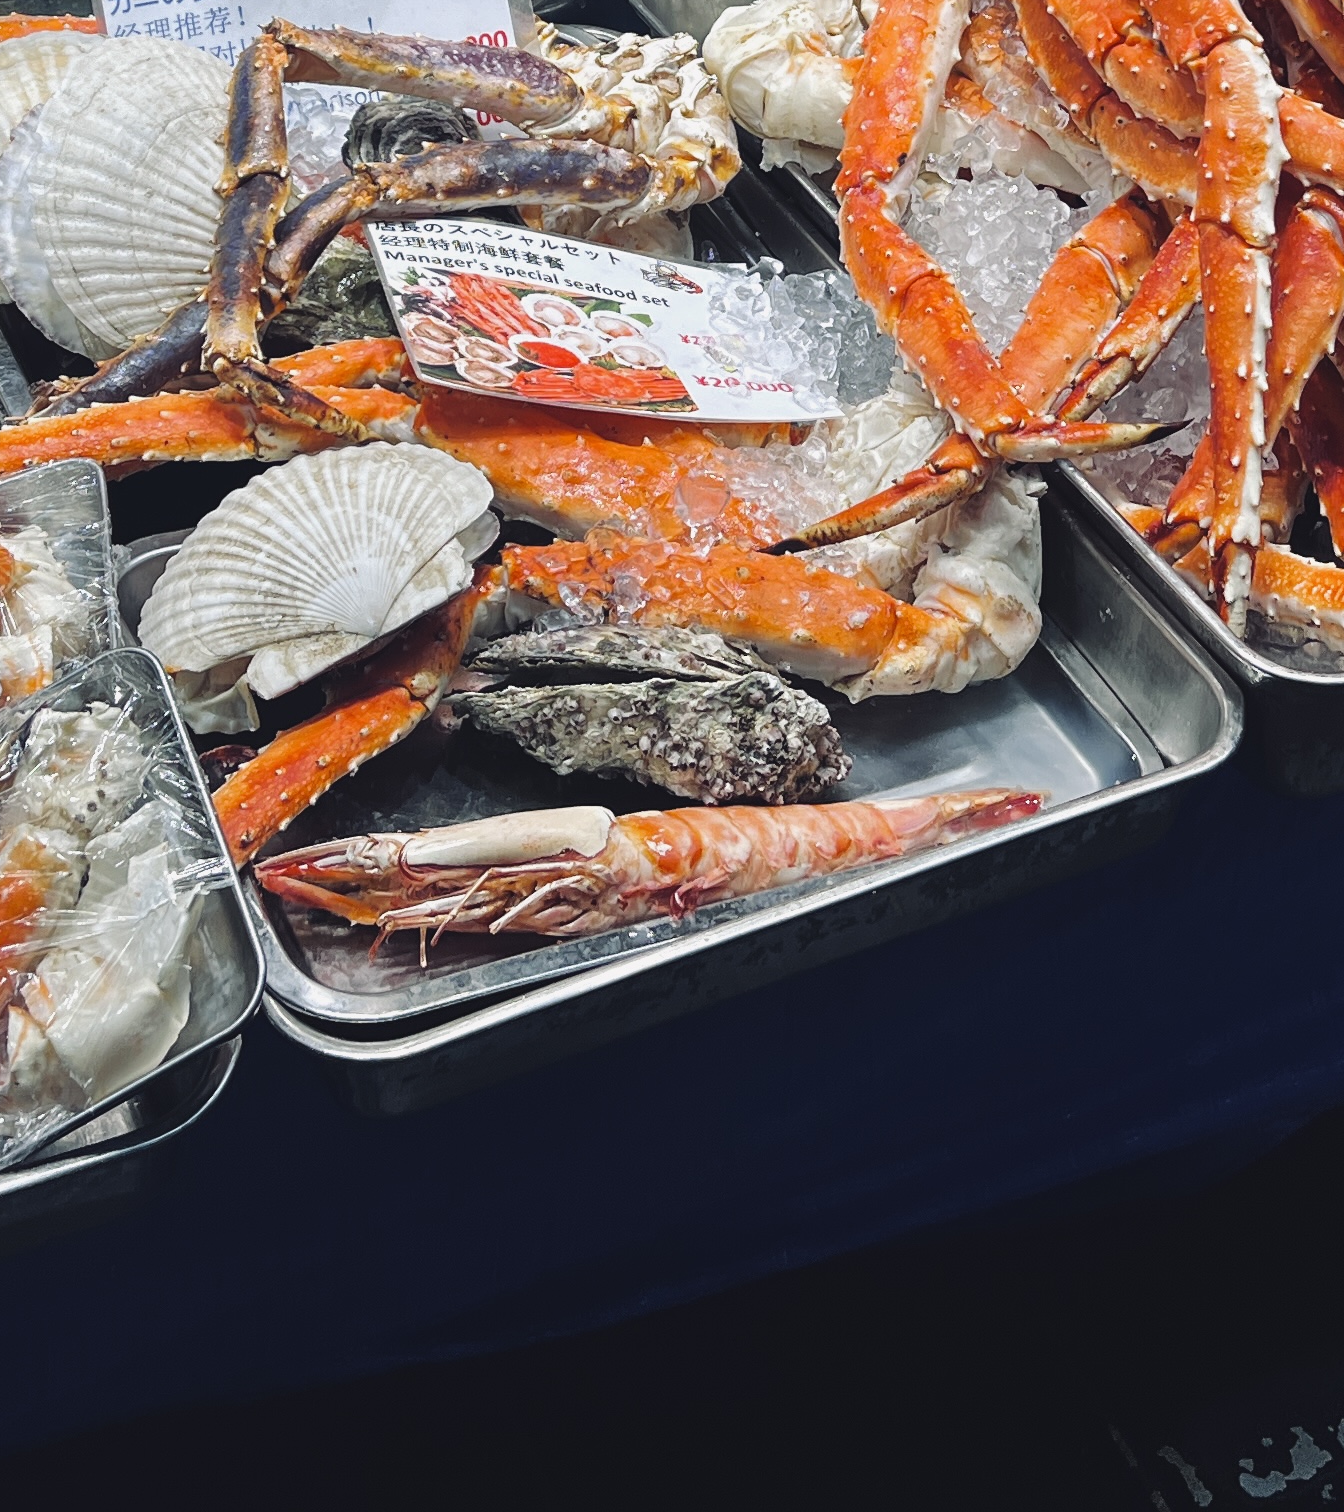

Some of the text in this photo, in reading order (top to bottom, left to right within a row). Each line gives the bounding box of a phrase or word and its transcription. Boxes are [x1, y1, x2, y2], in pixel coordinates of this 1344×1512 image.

[384, 249, 671, 309] Manager's special seafood set
